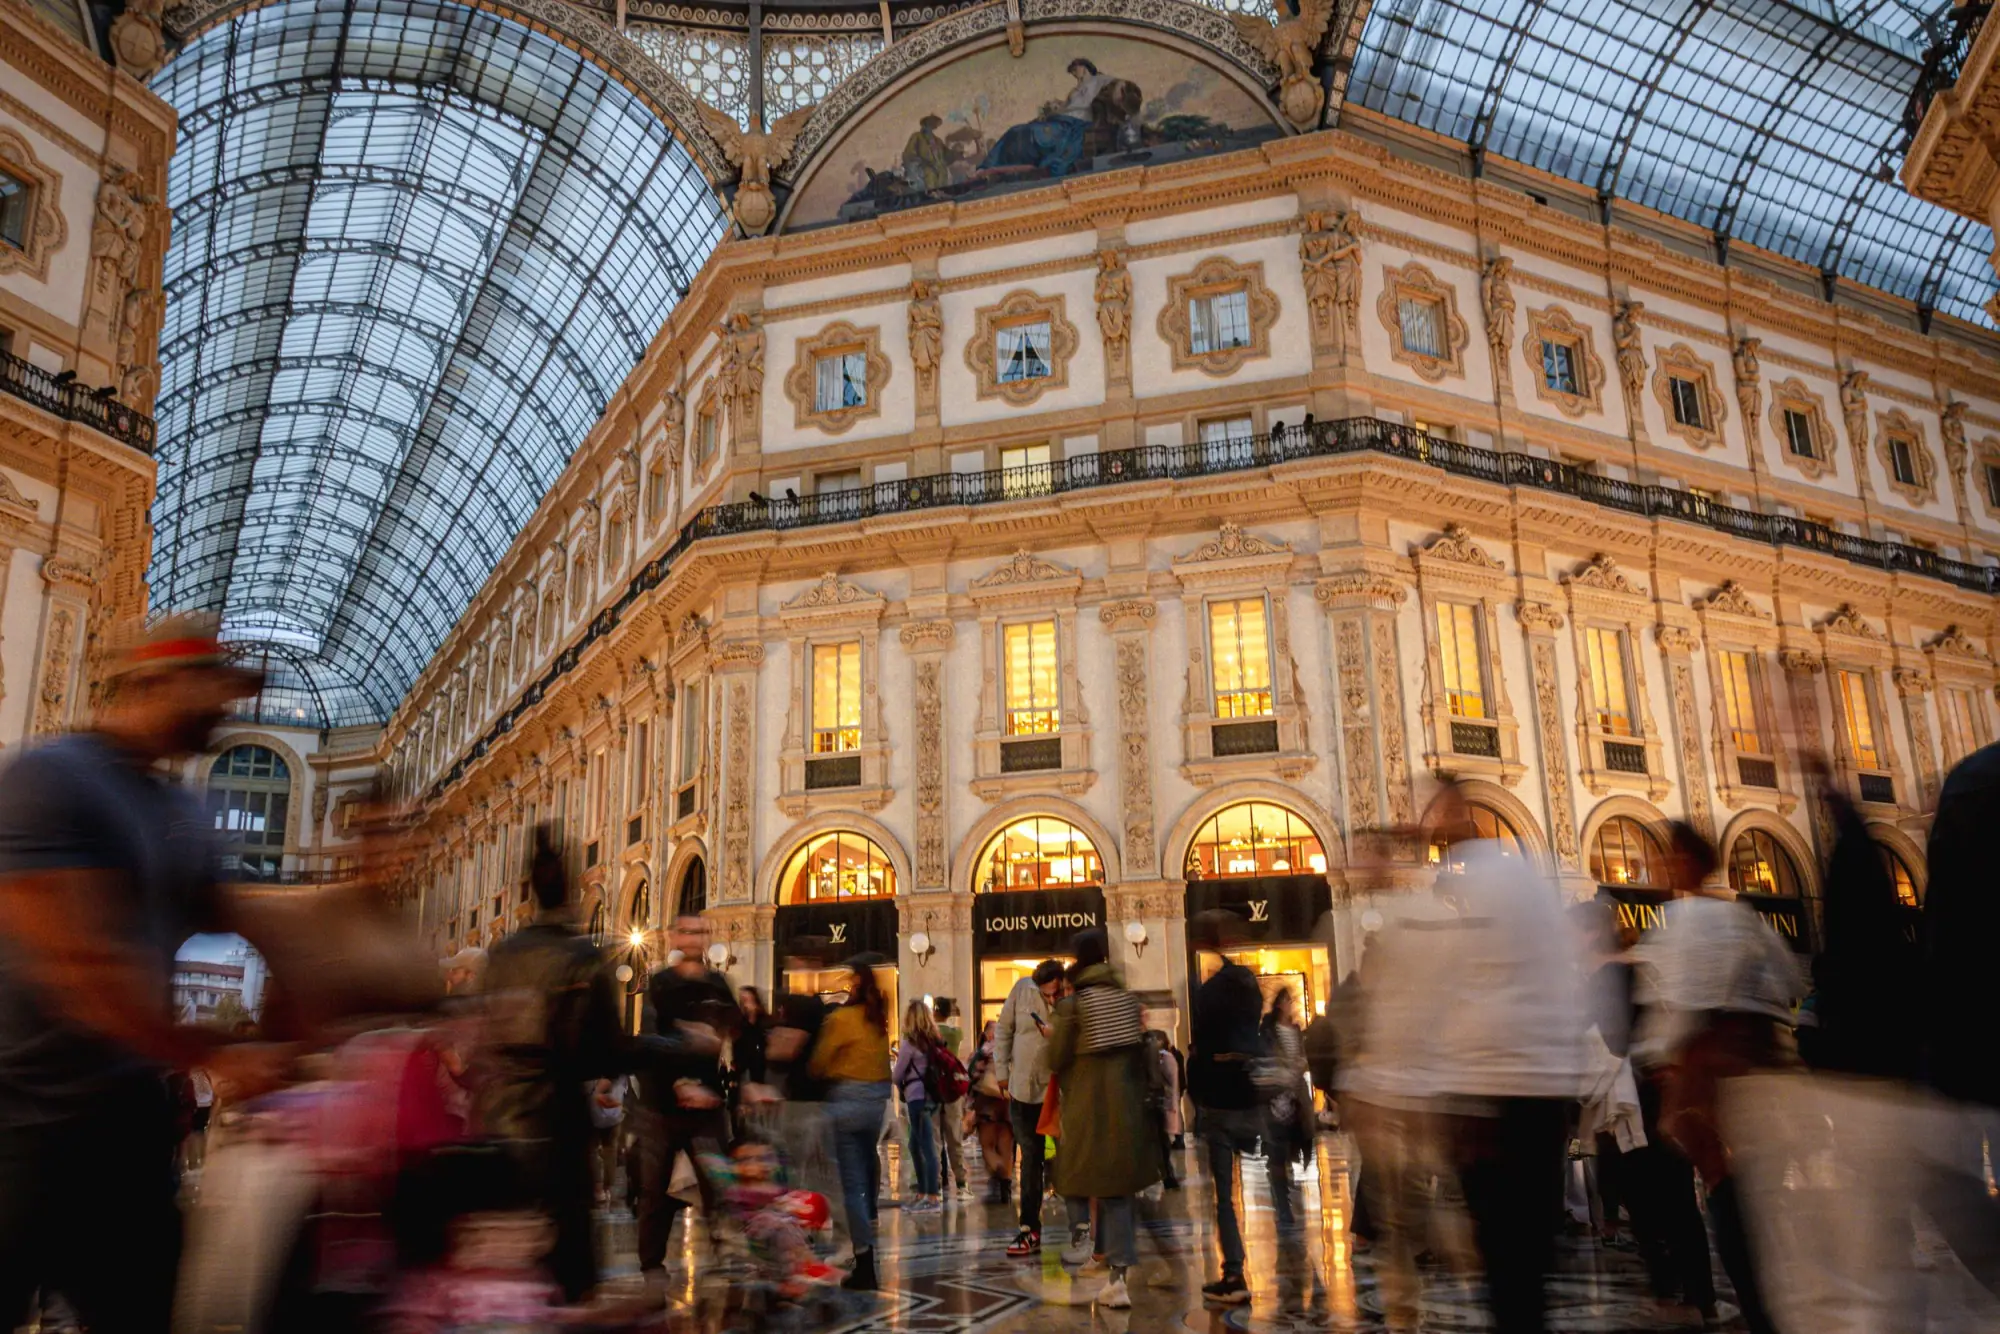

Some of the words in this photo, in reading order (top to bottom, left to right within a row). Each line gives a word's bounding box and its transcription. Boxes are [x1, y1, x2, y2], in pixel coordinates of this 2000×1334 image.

[985, 916, 1028, 932] LOUIS
[1031, 912, 1096, 929] VUITTON
[1608, 903, 1668, 930] AVINI
